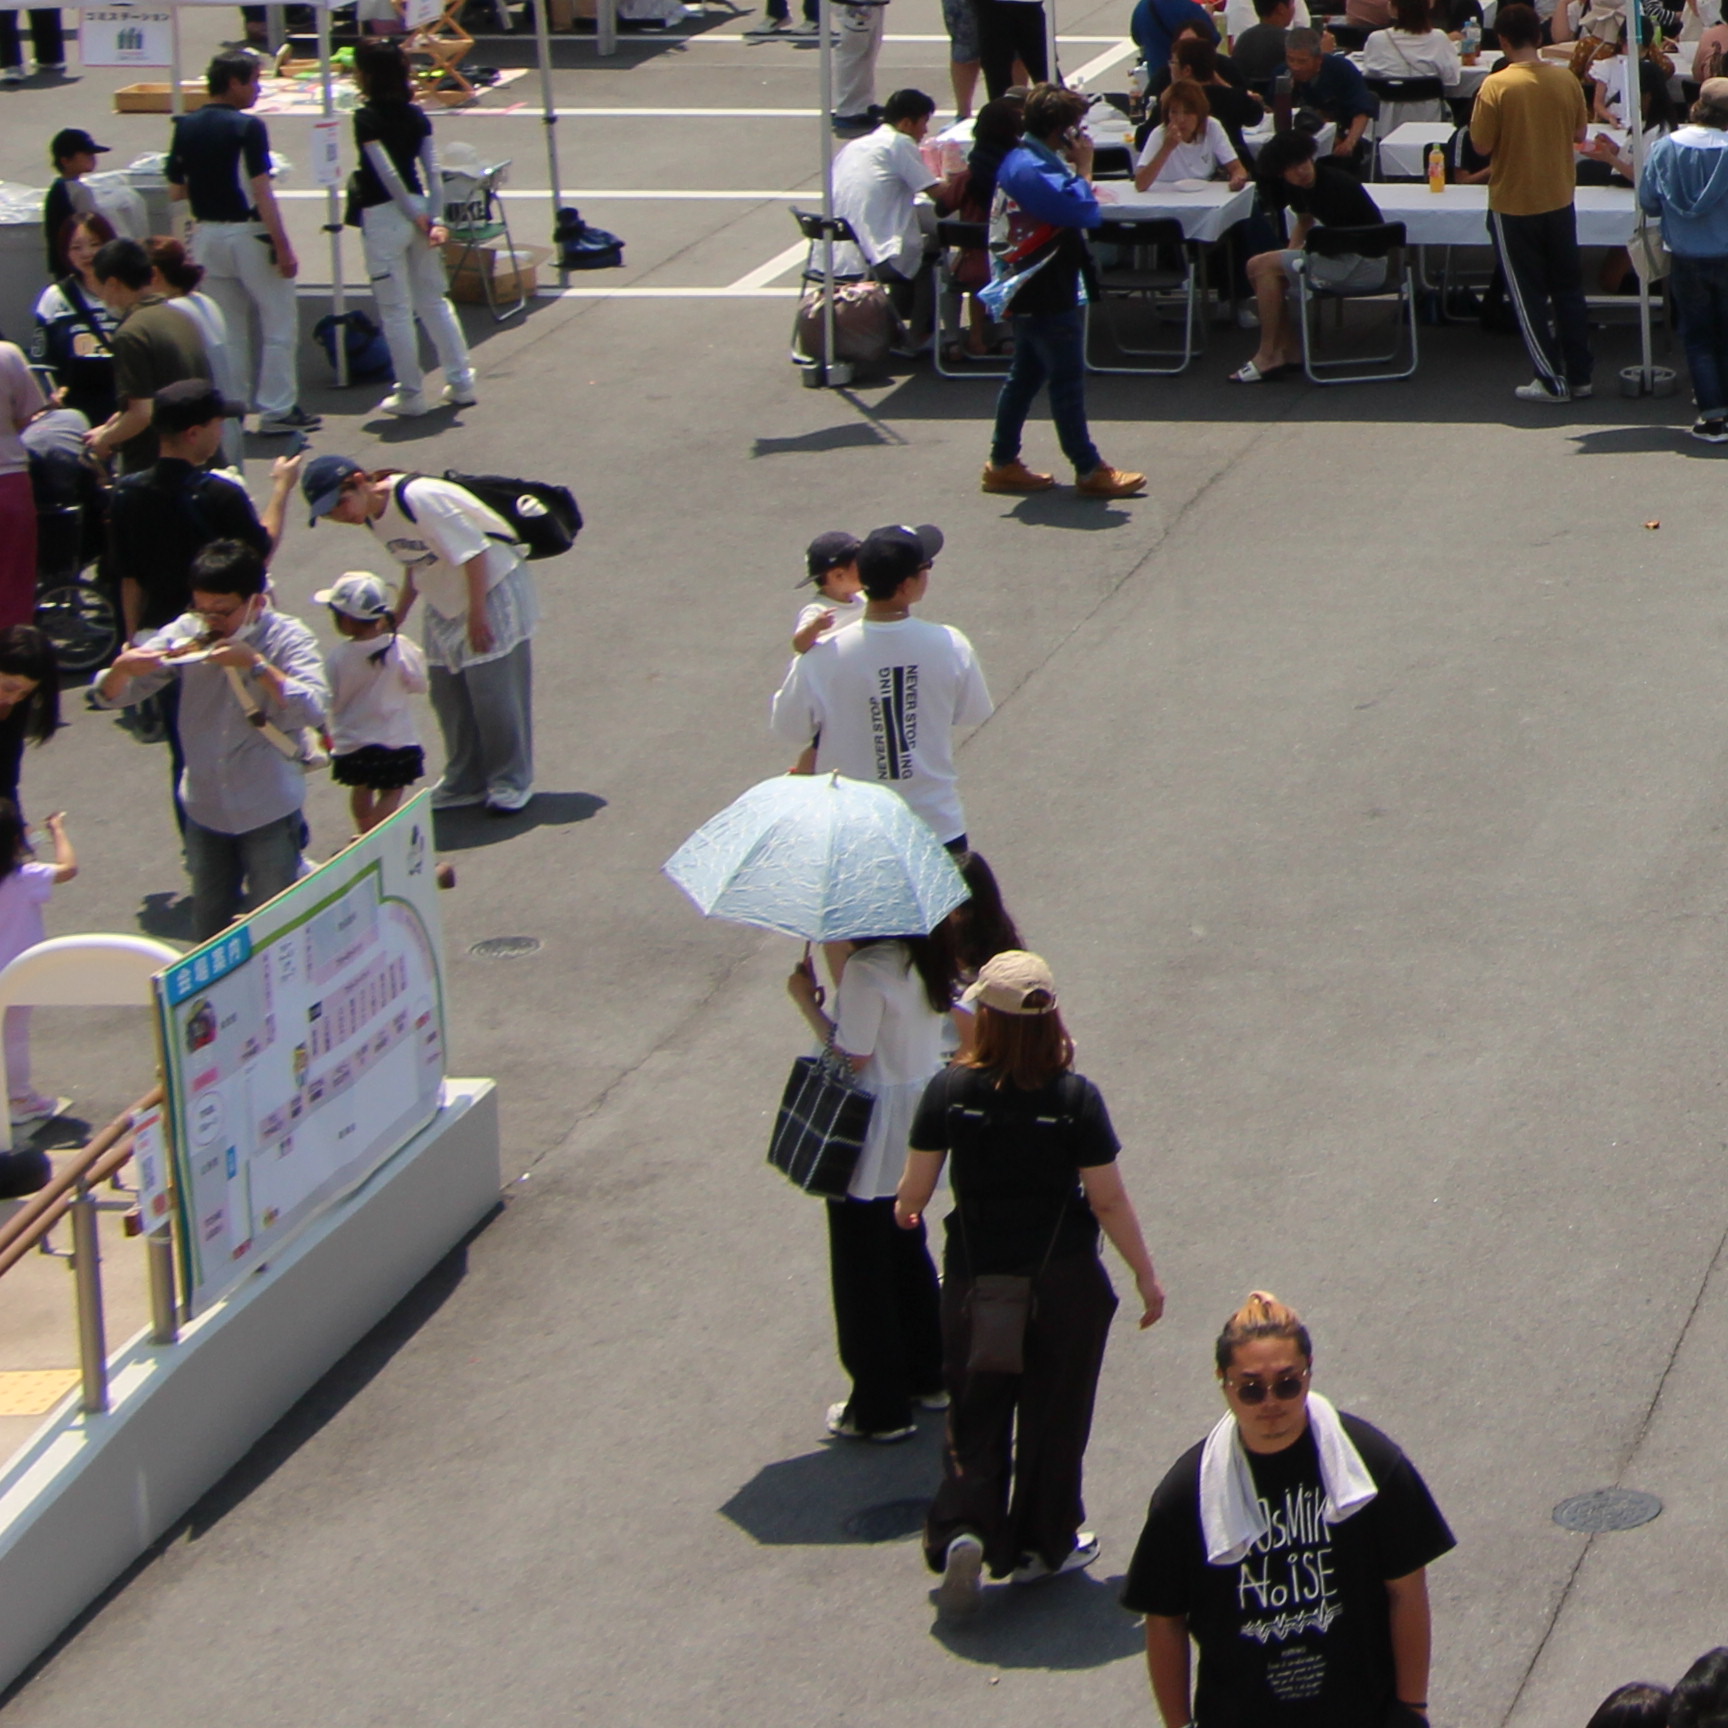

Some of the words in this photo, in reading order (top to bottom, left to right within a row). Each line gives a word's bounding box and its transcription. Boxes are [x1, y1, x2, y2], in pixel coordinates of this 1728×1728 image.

[878, 667, 892, 695] ING
[905, 665, 920, 711] NEVER
[874, 735, 888, 781] NEVER
[900, 753, 914, 781] ING
